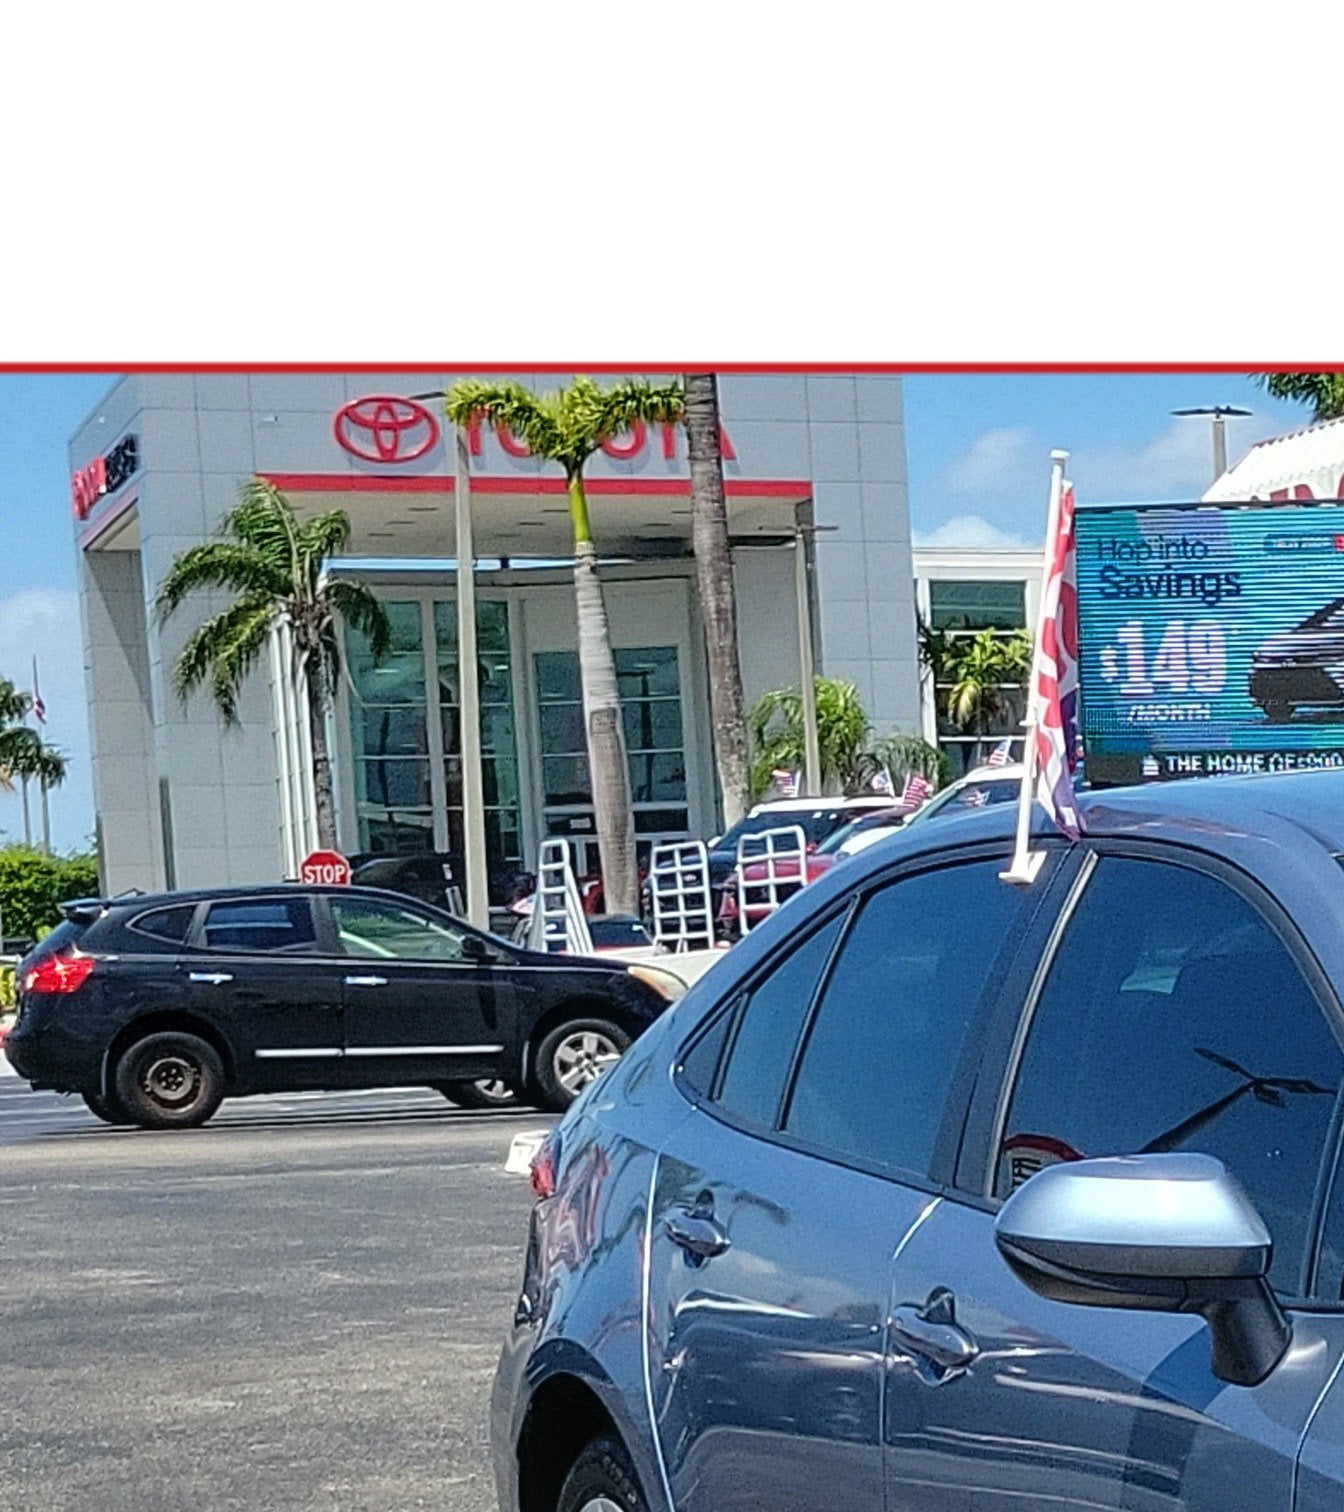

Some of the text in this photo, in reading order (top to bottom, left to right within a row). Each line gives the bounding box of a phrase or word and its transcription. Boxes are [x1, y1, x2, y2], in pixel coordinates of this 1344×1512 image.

[1100, 564, 1242, 606] Savings
[1166, 755, 1203, 774] THE
[1207, 753, 1265, 774] HOME
[304, 864, 346, 884] STOP
